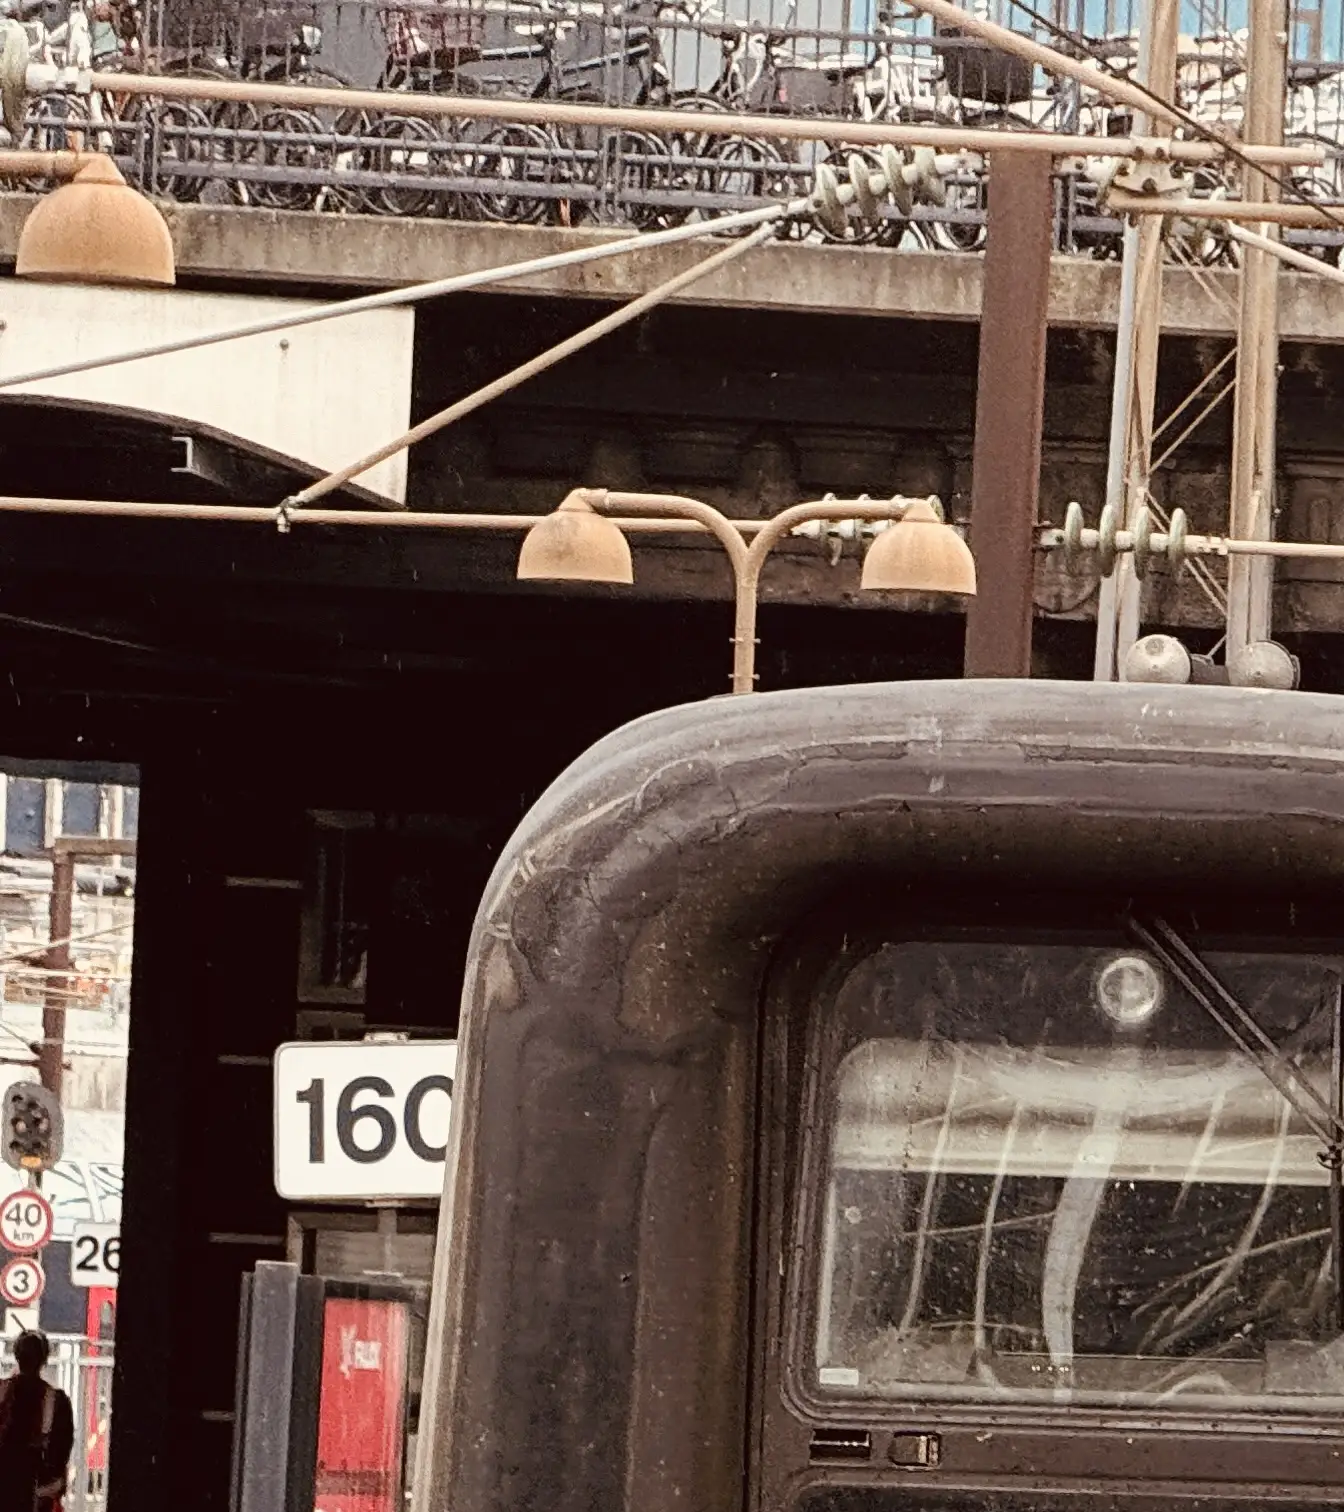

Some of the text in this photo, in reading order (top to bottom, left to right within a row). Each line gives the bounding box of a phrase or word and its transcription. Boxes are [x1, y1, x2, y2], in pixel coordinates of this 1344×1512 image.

[296, 1074, 454, 1164] 160
[5, 1203, 42, 1227] 40
[13, 1229, 35, 1241] km
[13, 1269, 30, 1293] 3
